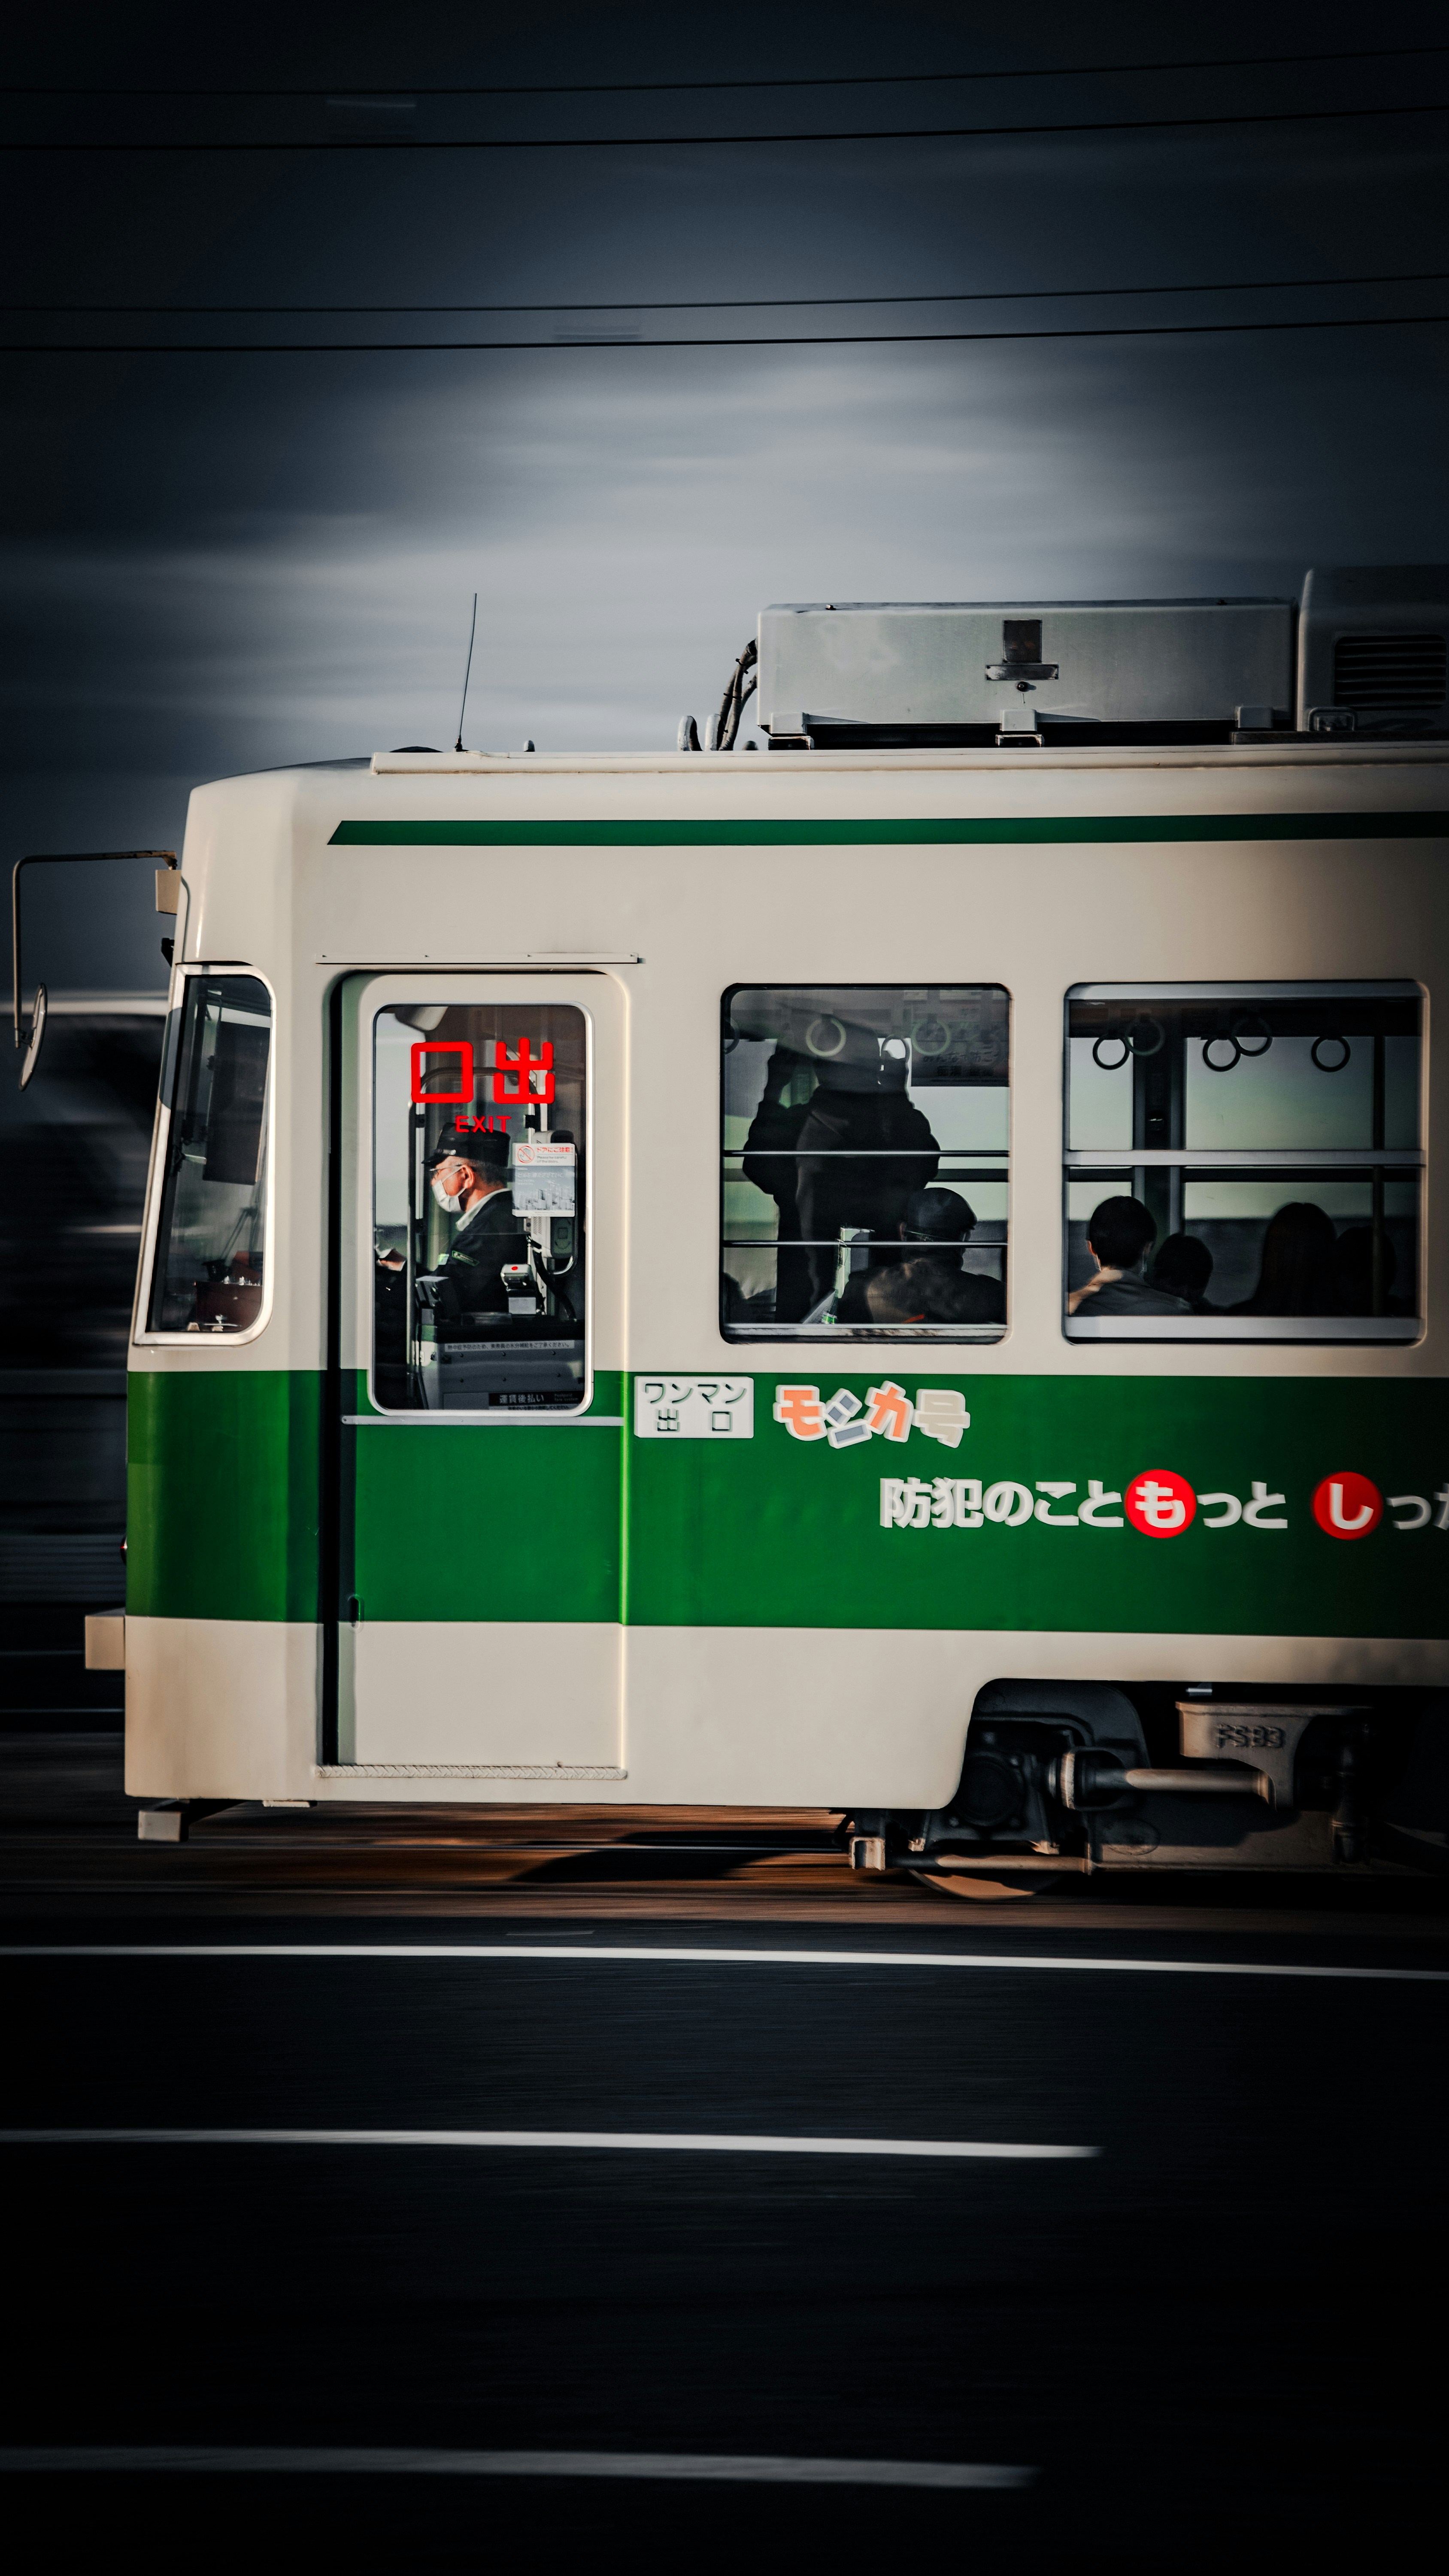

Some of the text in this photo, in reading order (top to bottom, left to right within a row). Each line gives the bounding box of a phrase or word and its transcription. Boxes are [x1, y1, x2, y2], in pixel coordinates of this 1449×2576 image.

[455, 1115, 511, 1133] EXIT
[645, 1382, 747, 1404] ワンマン
